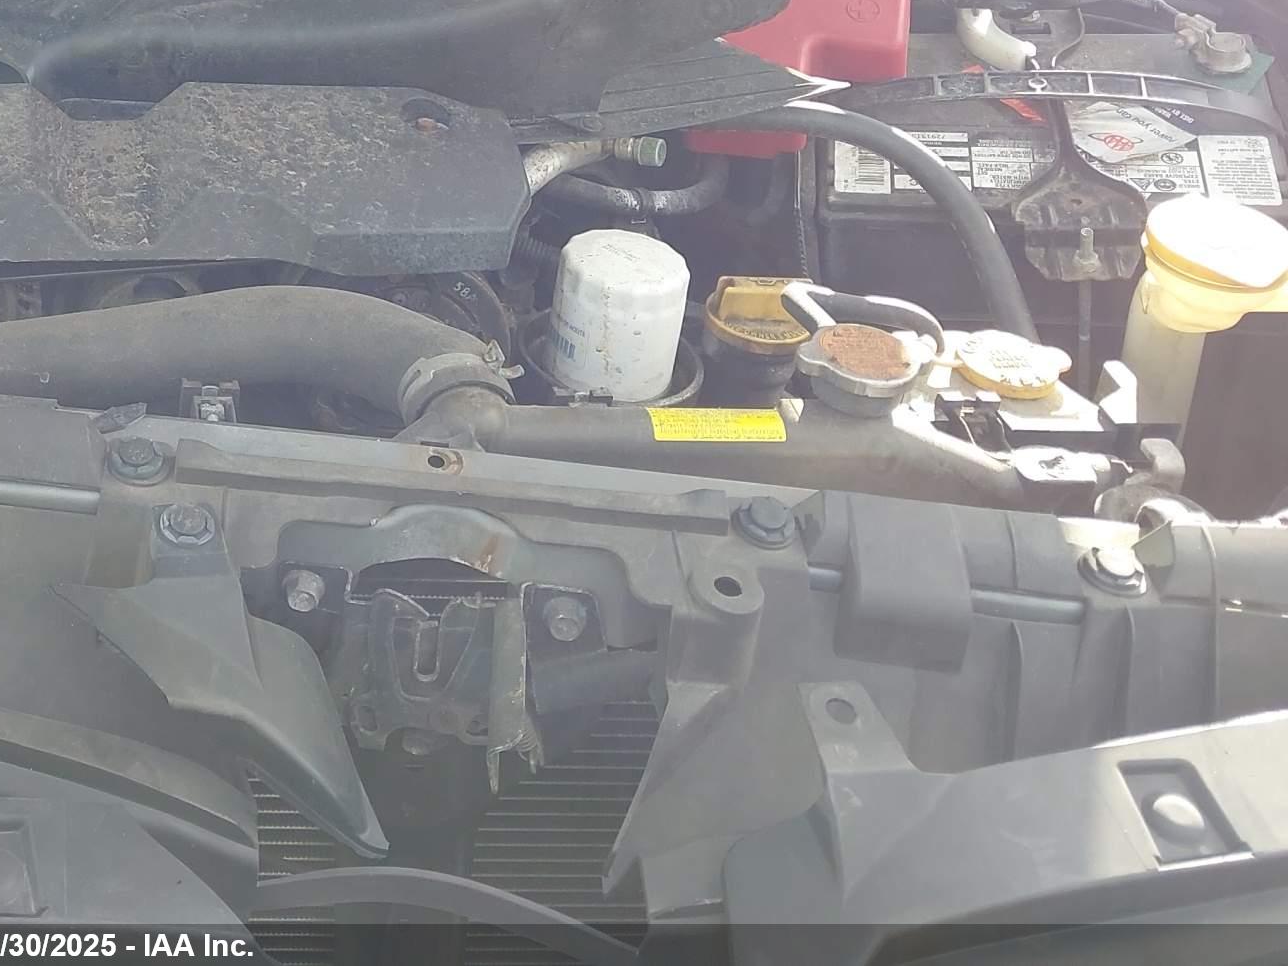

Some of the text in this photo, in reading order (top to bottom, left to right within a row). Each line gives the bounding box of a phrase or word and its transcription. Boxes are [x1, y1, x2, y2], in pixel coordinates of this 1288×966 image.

[1116, 107, 1133, 119] can
[1132, 116, 1150, 130] you
[1104, 135, 1135, 151] AAA
